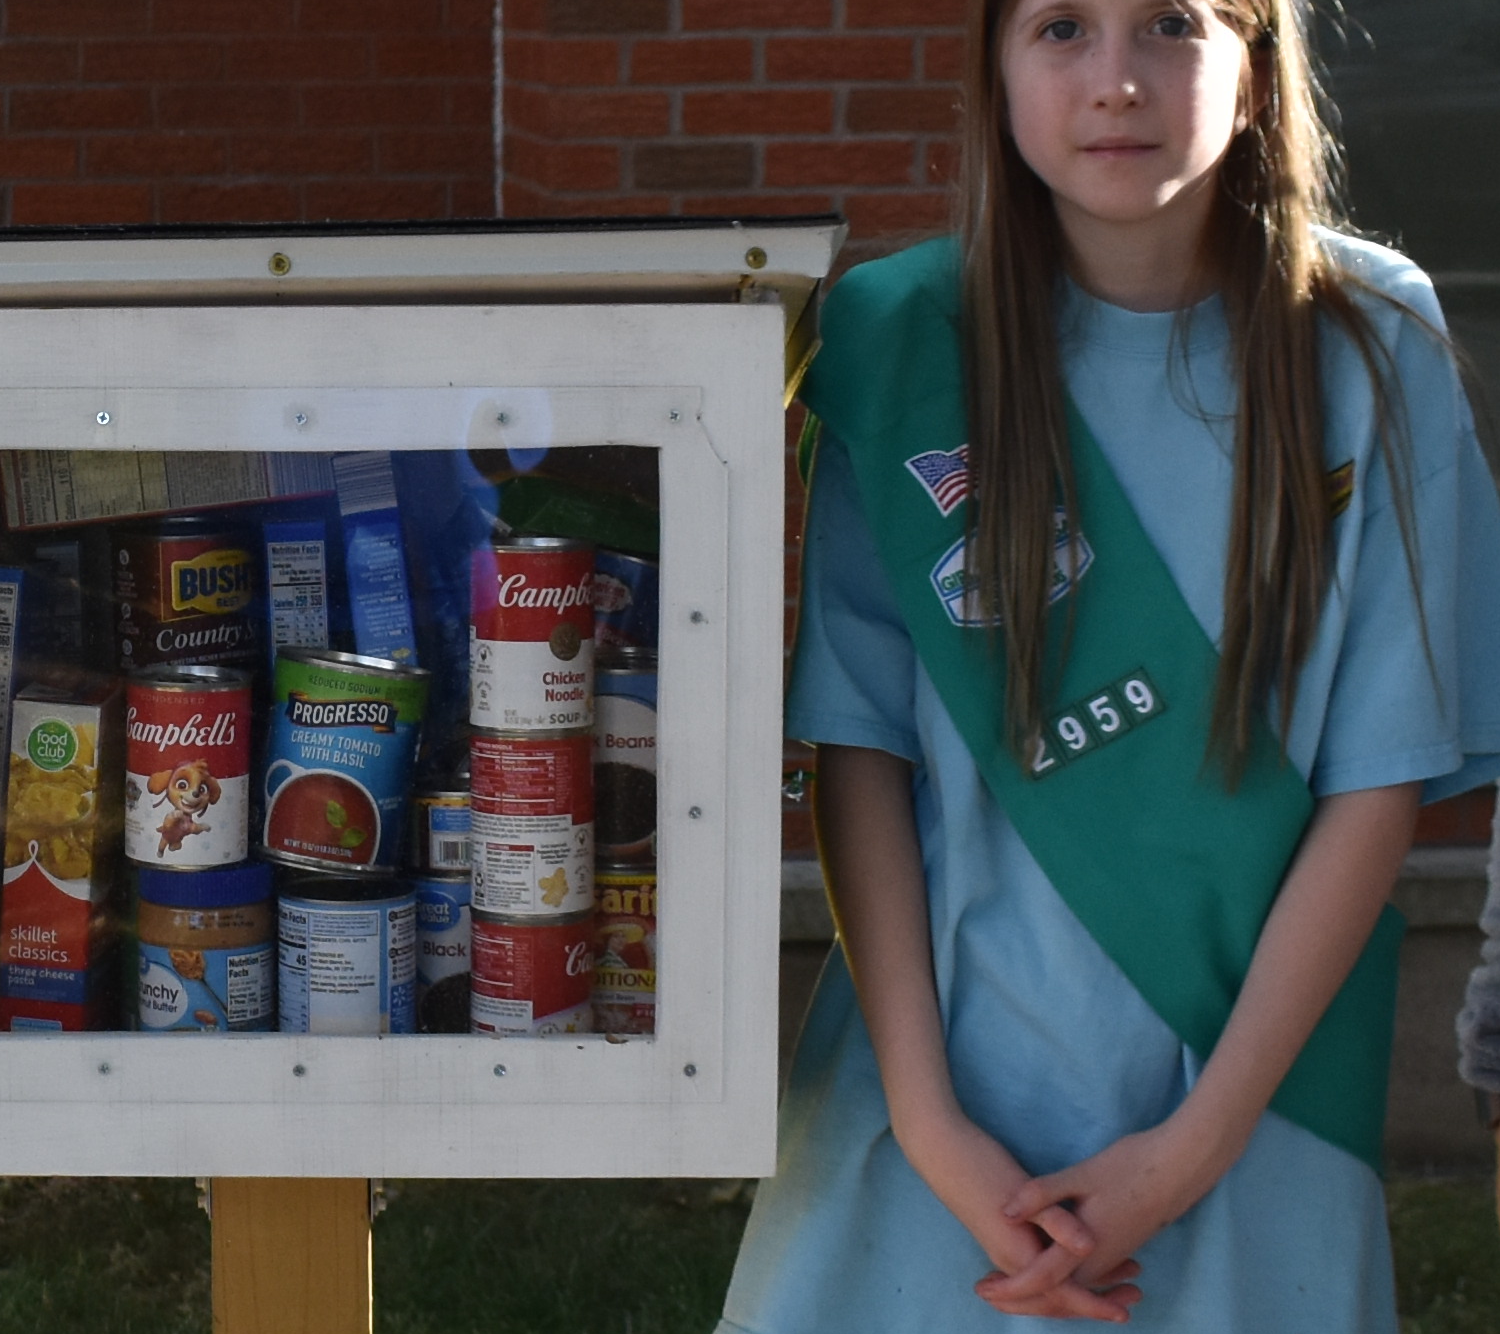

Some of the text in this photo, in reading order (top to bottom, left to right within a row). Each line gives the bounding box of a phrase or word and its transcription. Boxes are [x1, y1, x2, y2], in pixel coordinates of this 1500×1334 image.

[179, 563, 250, 602] BUSH
[156, 623, 243, 652] Country
[309, 675, 345, 690] REDUCED
[347, 681, 381, 695] SODIUM
[542, 671, 586, 686] Chicken
[545, 687, 585, 703] Noodle
[292, 701, 389, 725] PROGRESSO
[549, 712, 580, 725] SOUP
[37, 729, 68, 746] food
[126, 706, 237, 753] Campbell's
[291, 730, 381, 757] CREAMY TOMATO
[606, 733, 656, 749] Beans
[37, 743, 66, 758] club
[300, 745, 366, 769] WITH BASIL
[9, 924, 58, 945] skillet
[8, 941, 69, 964] classics
[422, 940, 467, 958] Black
[228, 956, 260, 968] Nutrition
[295, 954, 307, 967] 45
[7, 974, 35, 986] pasta
[8, 964, 76, 981] three cheese
[228, 968, 249, 979] Facts
[152, 1000, 178, 1013] Butter
